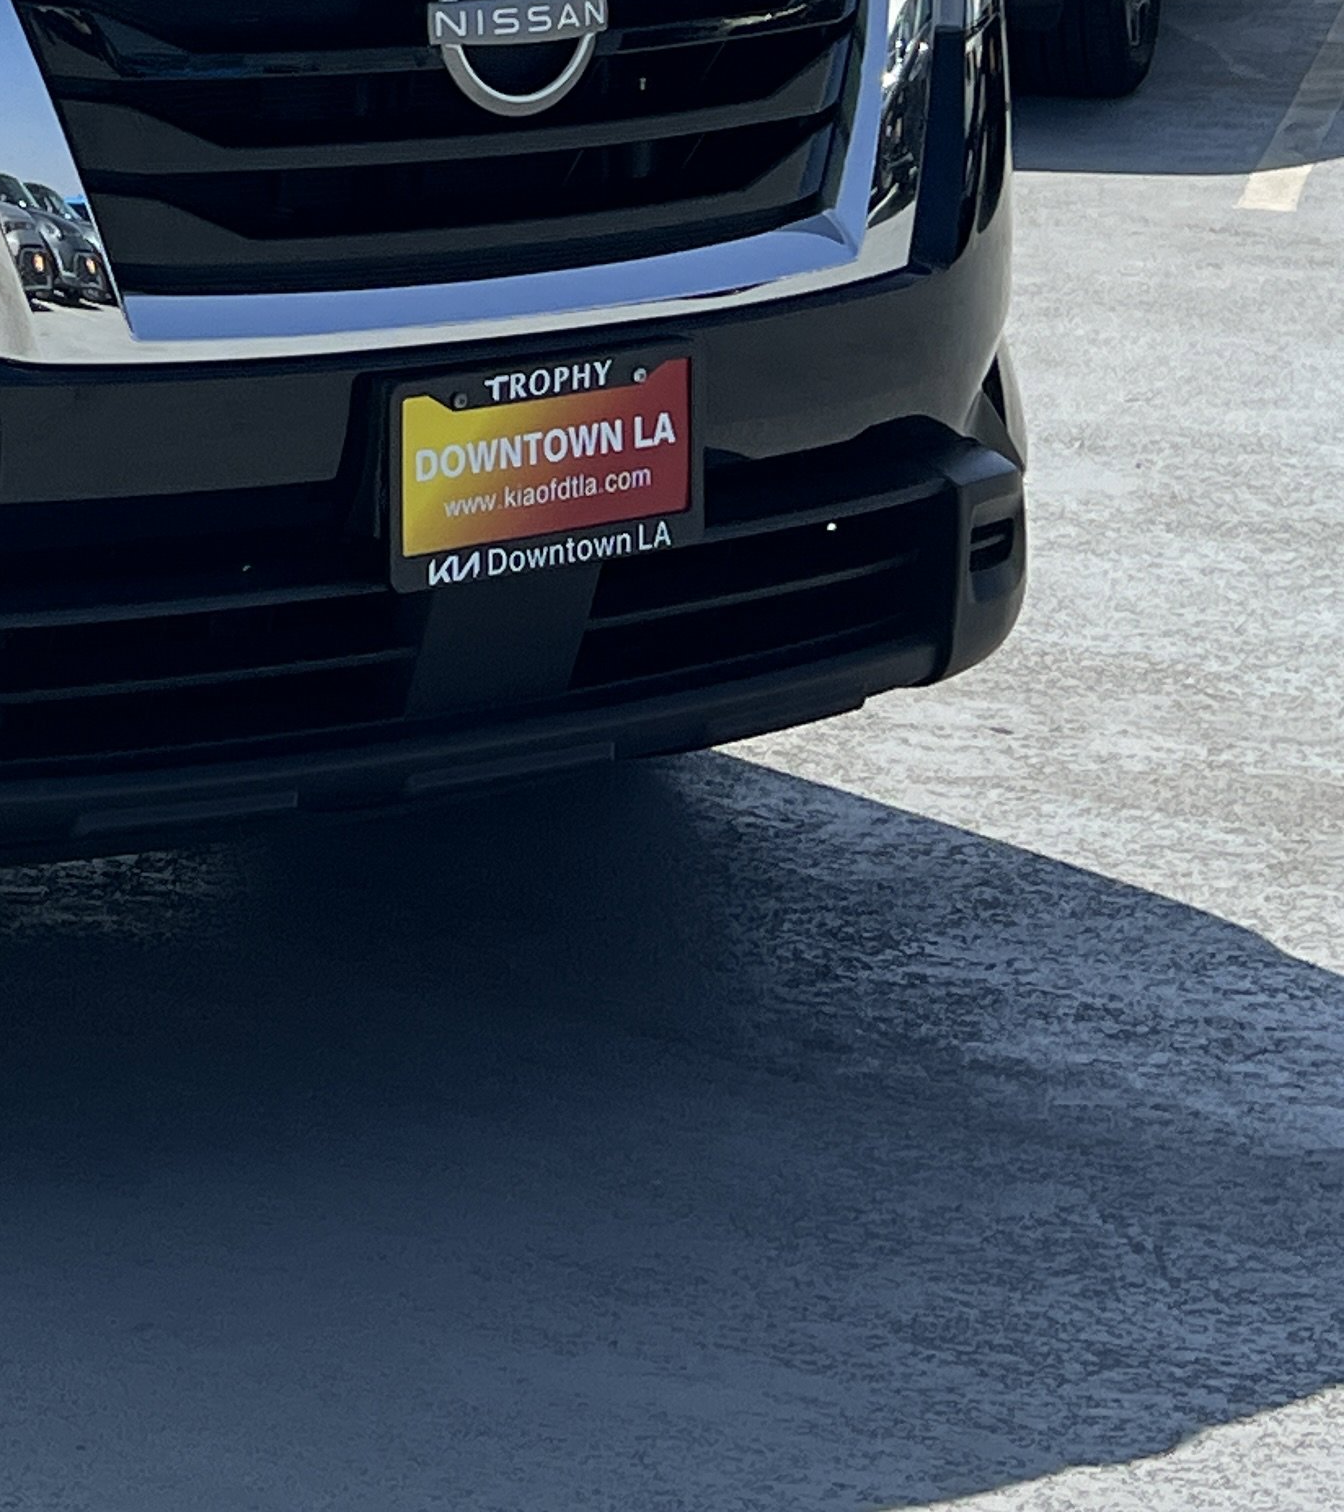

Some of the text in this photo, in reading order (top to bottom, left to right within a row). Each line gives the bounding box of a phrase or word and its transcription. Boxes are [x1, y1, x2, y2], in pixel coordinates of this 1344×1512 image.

[484, 360, 613, 401] TROPHY
[416, 412, 676, 482] DOWNTOWN LA
[443, 466, 652, 518] www.kiaofdtla.com
[488, 533, 632, 576] Downtown
[638, 521, 672, 551] LA
